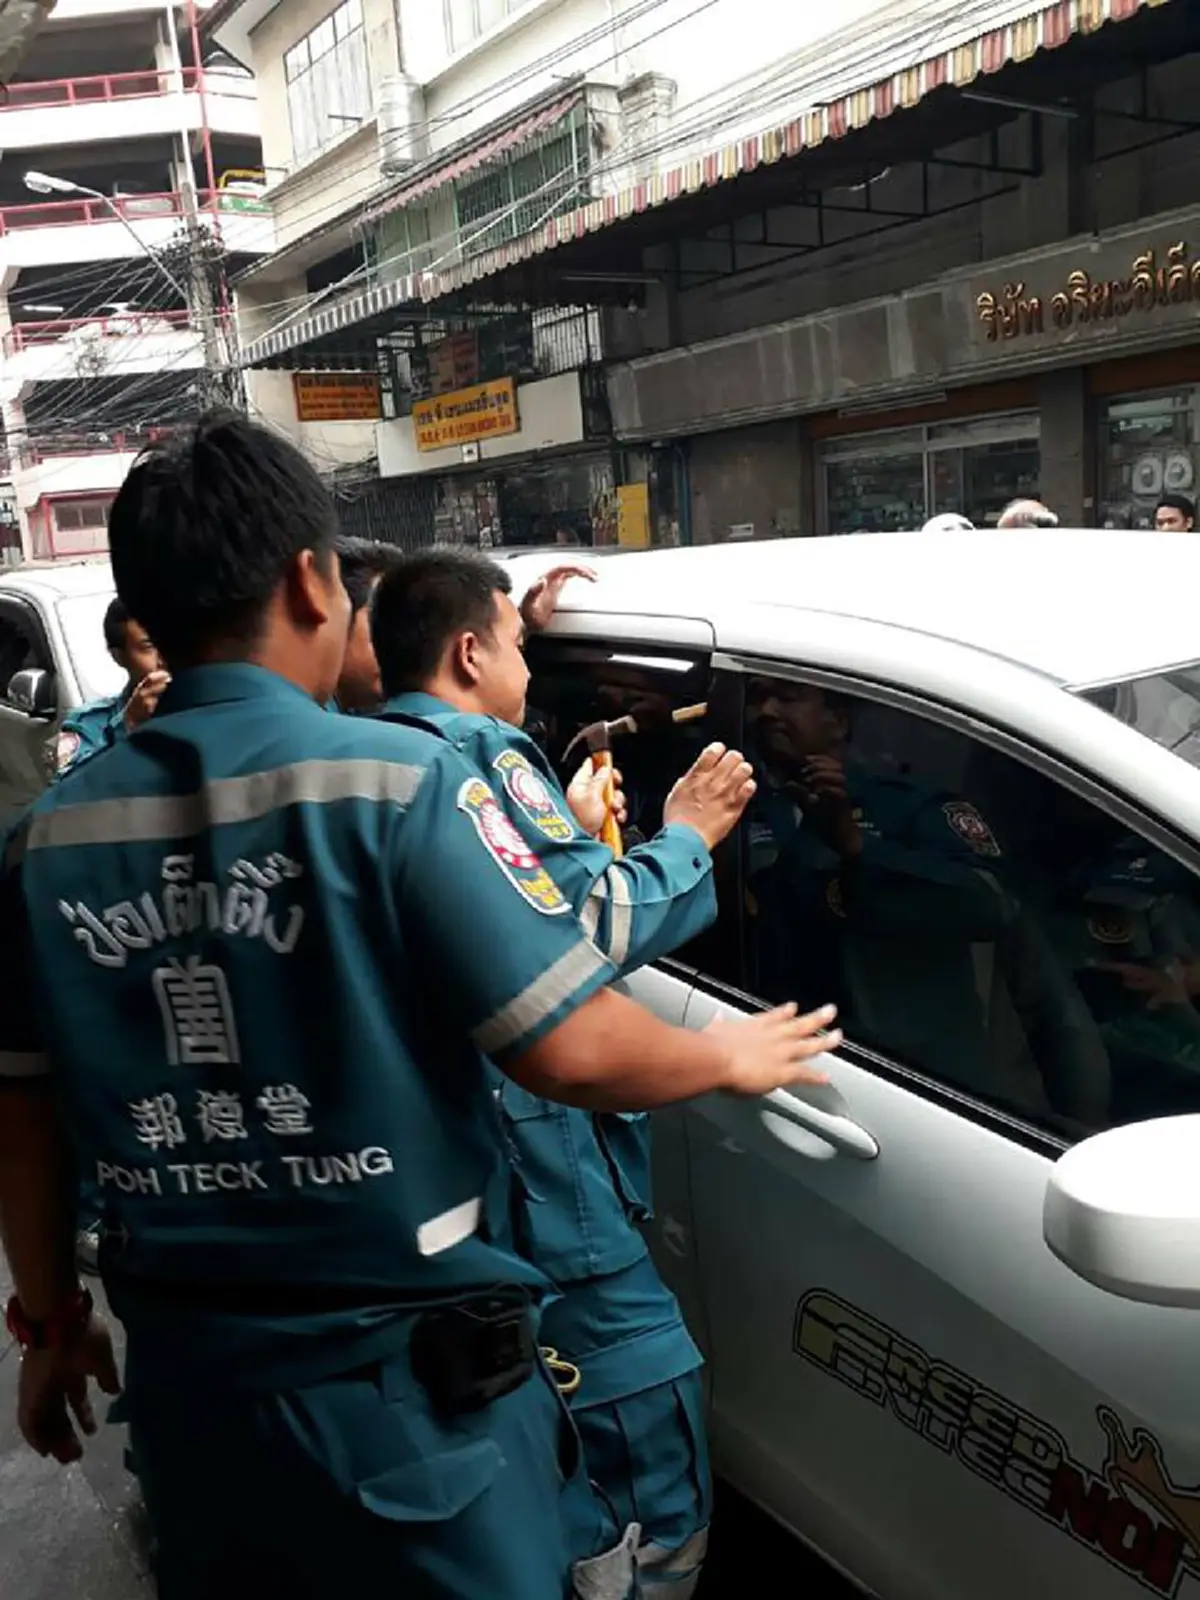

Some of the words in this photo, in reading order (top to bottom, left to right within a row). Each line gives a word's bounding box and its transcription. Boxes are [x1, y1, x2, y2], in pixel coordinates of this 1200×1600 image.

[96, 1161, 162, 1196] POH
[168, 1161, 269, 1194] TECK
[282, 1146, 396, 1188] TUNG
